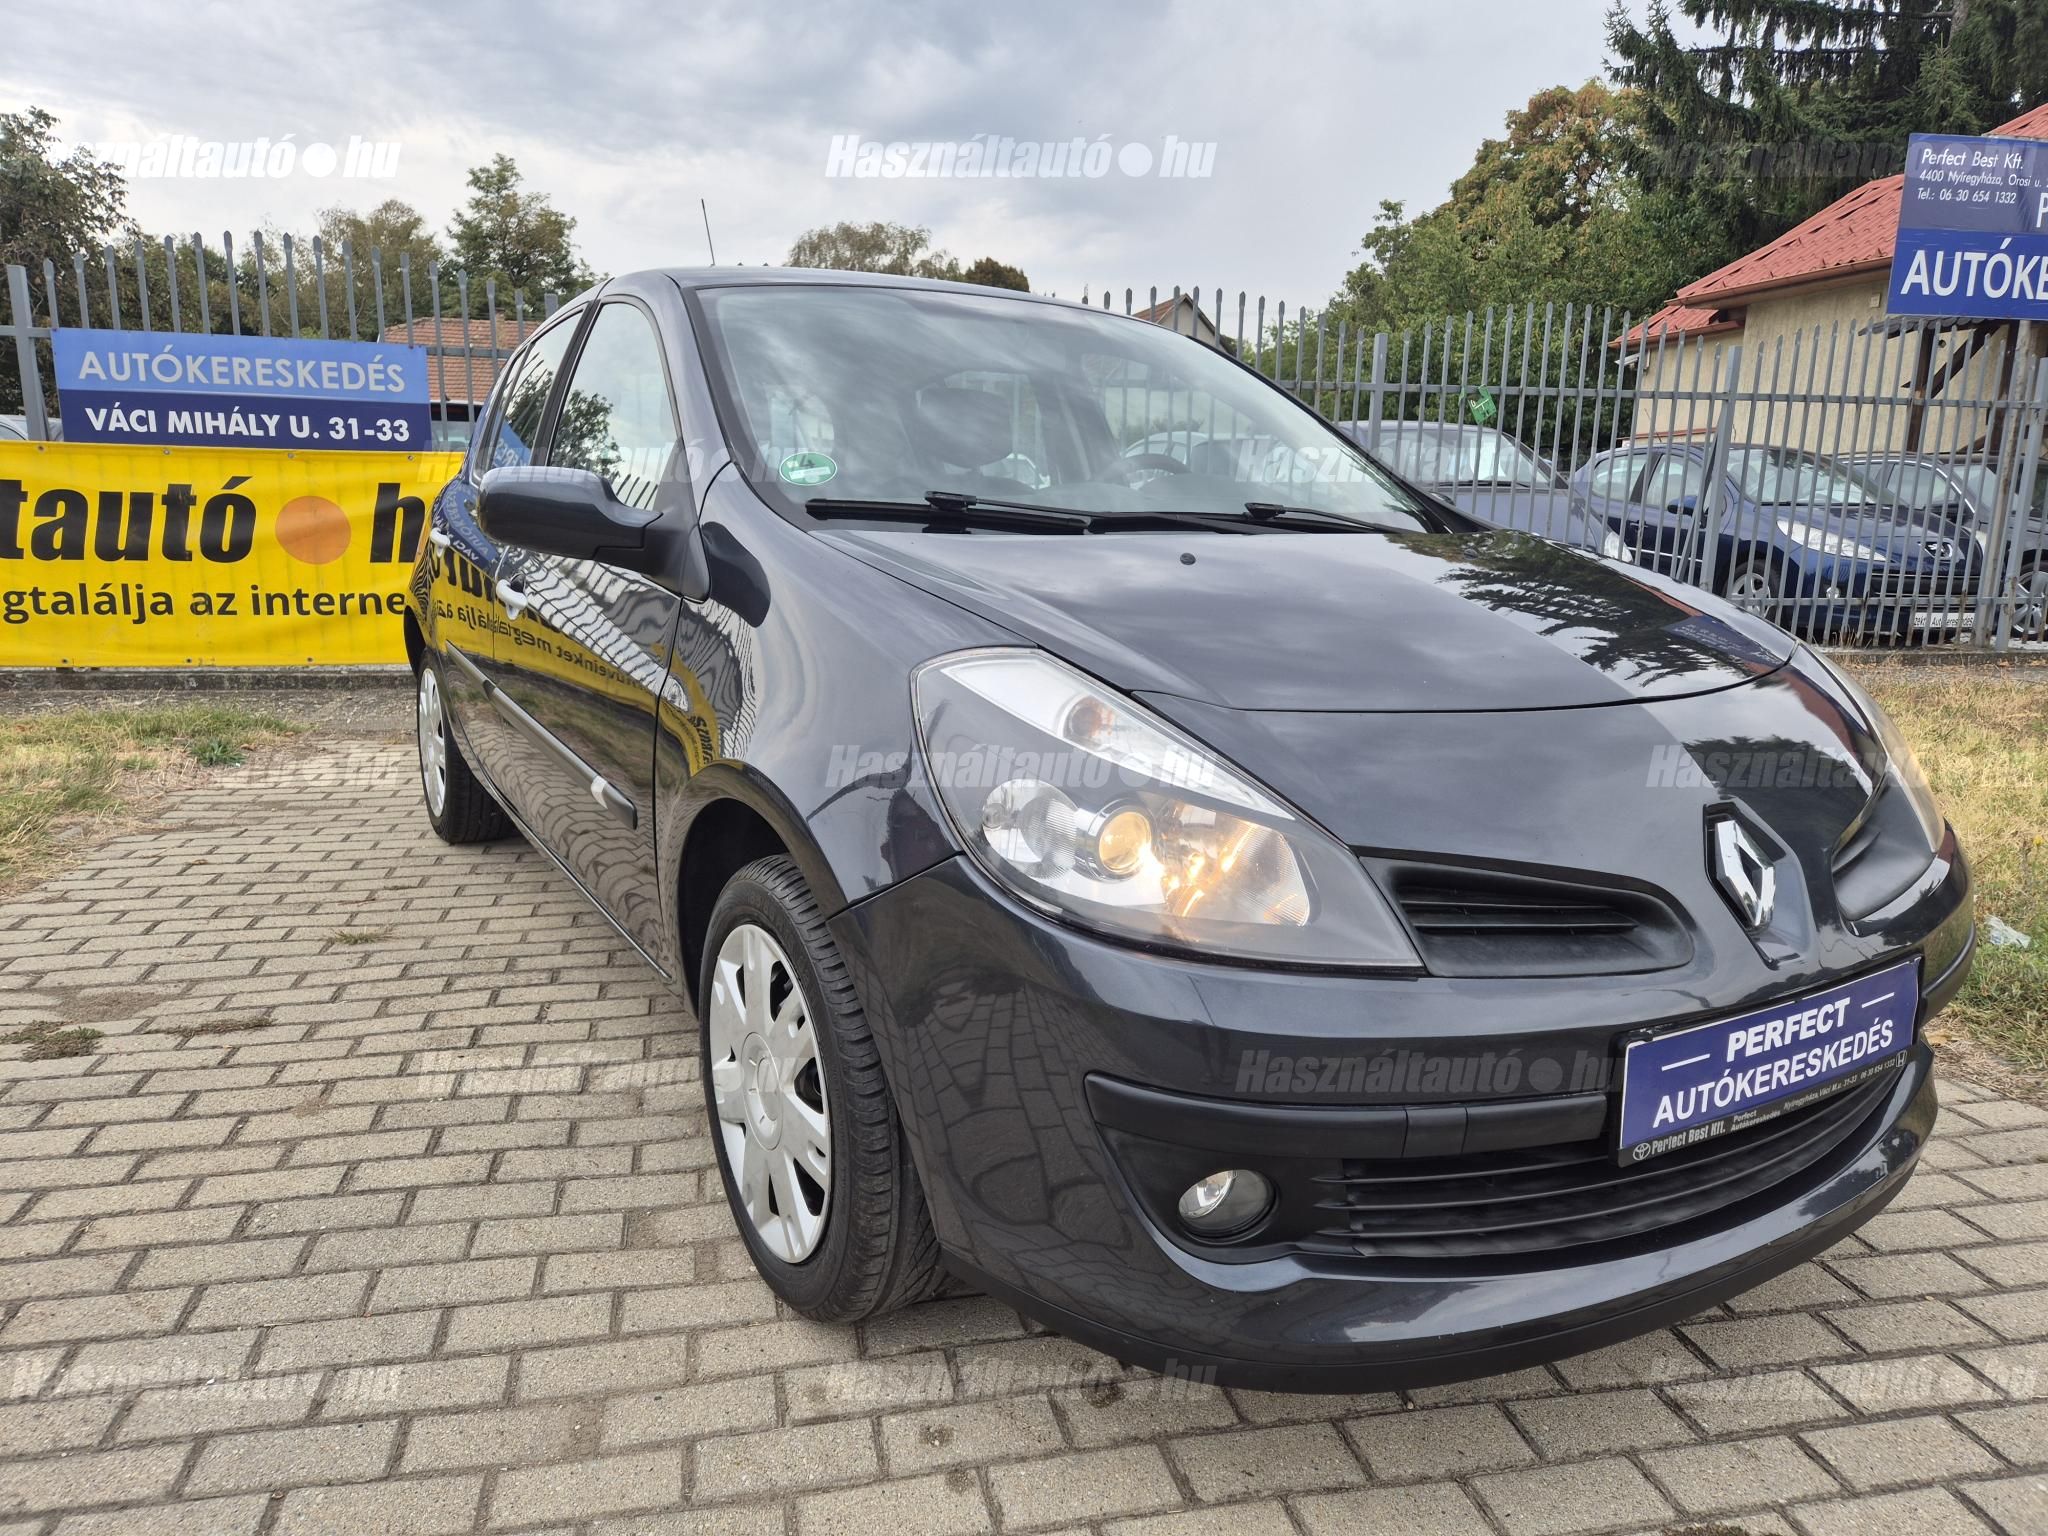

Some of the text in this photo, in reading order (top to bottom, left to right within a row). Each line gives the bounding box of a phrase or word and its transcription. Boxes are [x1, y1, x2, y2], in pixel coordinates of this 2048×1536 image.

[1921, 148, 2024, 169] Perfect Best Kft.
[1919, 169, 1944, 182] 4400
[1947, 171, 2003, 186] Nyíregyháza,
[2008, 174, 2032, 186] Orosi
[1939, 189, 1952, 201] 06
[1955, 190, 1969, 202] 30
[1972, 191, 1990, 202] 654
[1994, 192, 2017, 204] 1332
[78, 344, 407, 393] AUTÓKERESKEDÉS
[85, 402, 410, 442] VÁCI MIHÁLY U. 31-33
[190, 592, 238, 617] az
[1727, 997, 1851, 1062] PERFECT
[1653, 1017, 1893, 1128] AUTÓKERESKEDÉS
[1652, 1134, 1687, 1155] Perfect
[1688, 1125, 1708, 1144] Best
